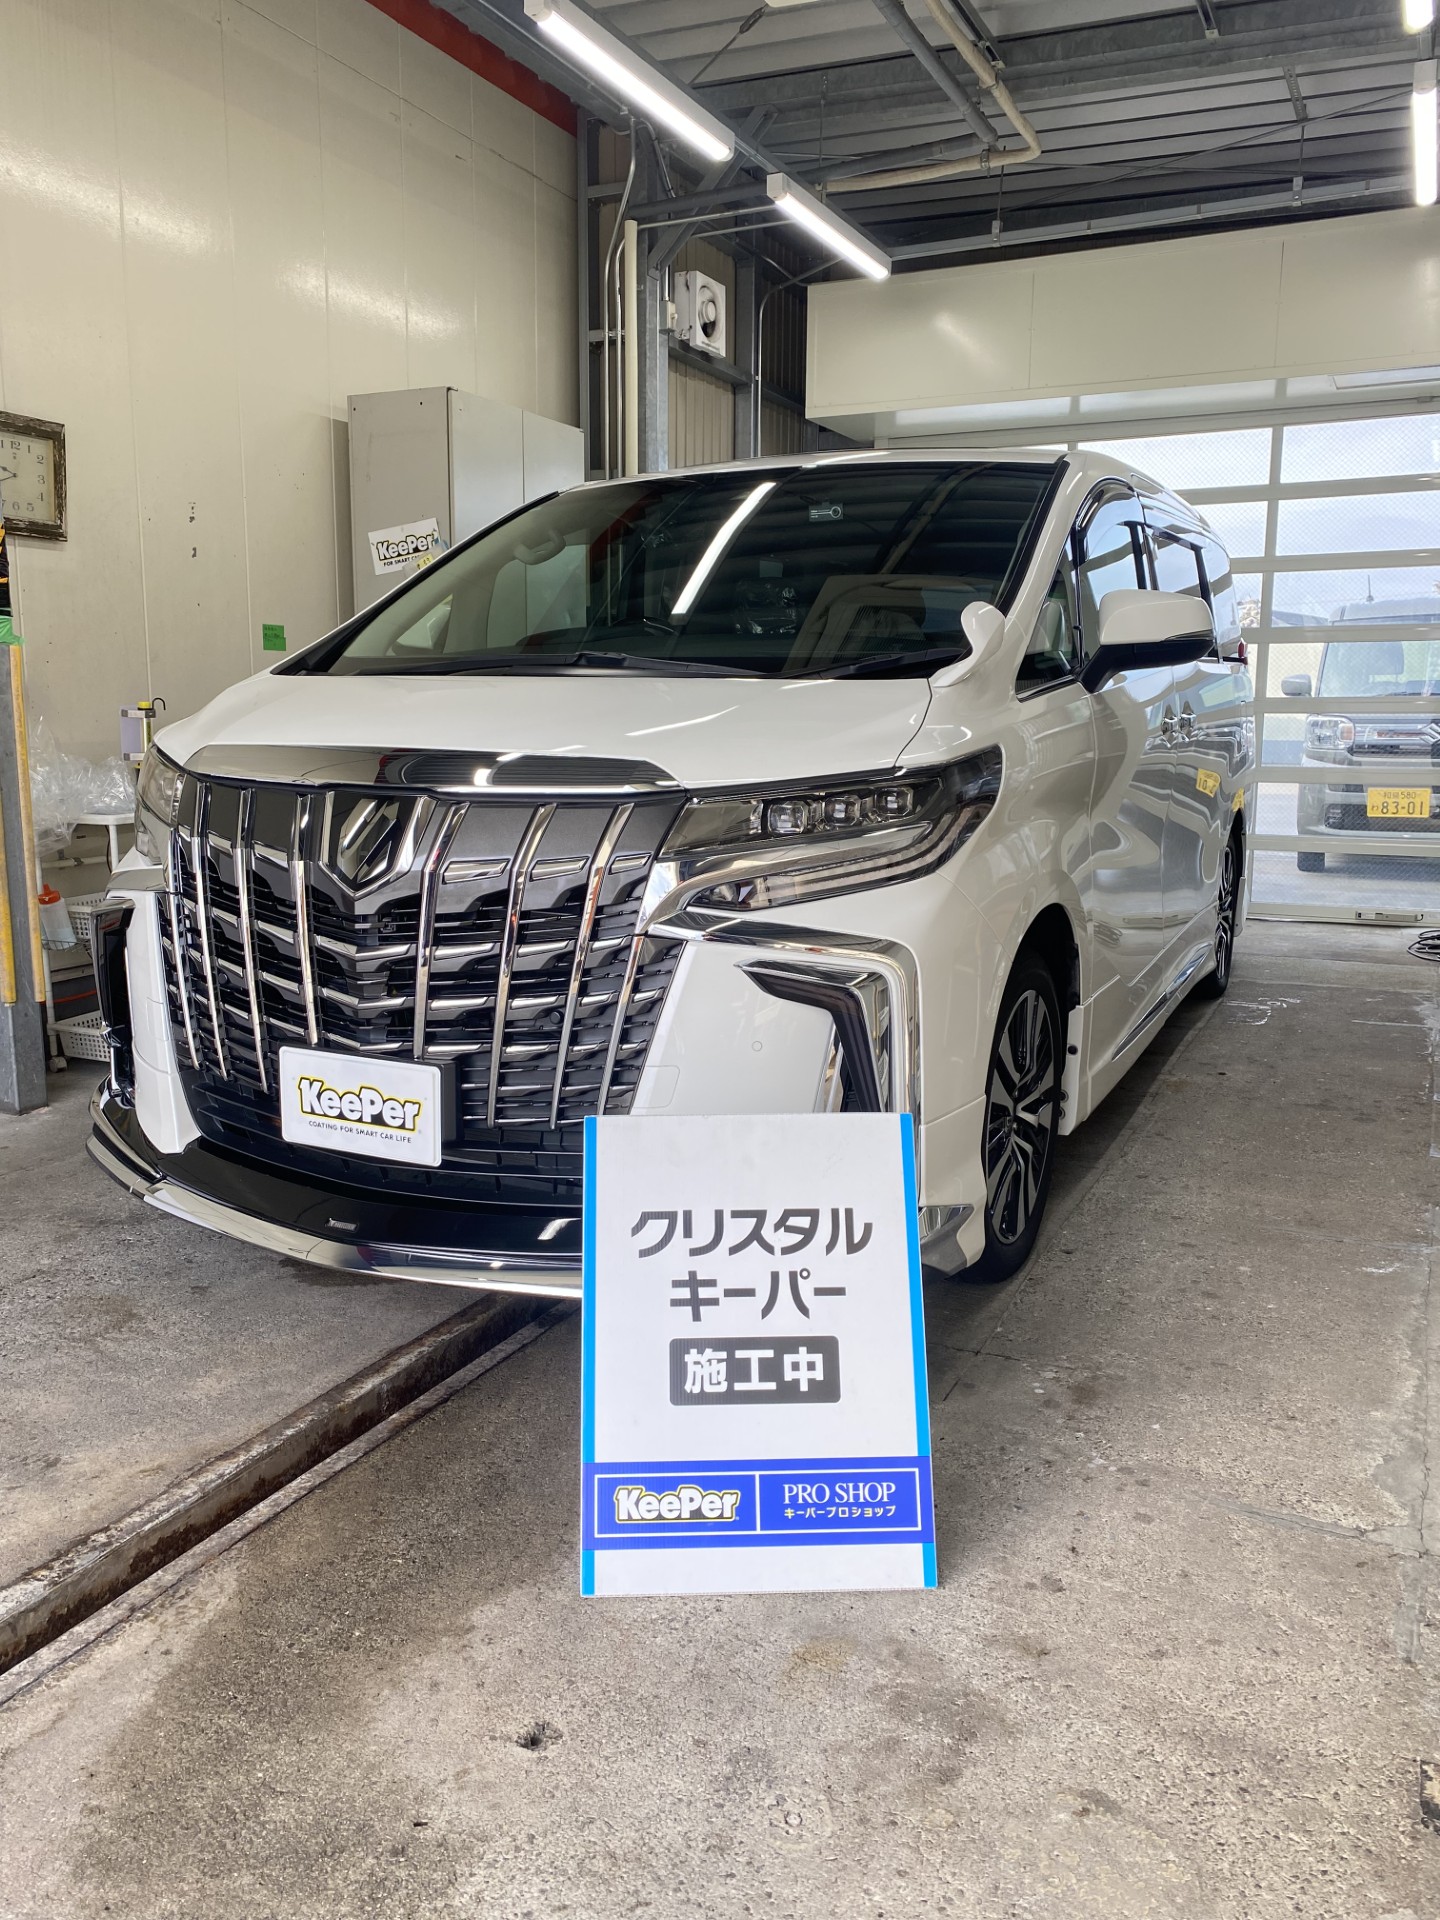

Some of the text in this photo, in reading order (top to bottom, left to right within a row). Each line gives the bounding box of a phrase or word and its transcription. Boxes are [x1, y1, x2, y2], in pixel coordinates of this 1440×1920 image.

[10, 441, 20, 450] 12
[28, 445, 30, 453] 1
[36, 455, 44, 464] 2
[38, 475, 45, 484] 3
[38, 492, 43, 501] 4
[12, 501, 20, 512] 6
[26, 502, 34, 512] 5
[376, 533, 434, 561] KeePer
[1381, 801, 1423, 815] 83-01
[298, 1076, 421, 1132] KeePer
[308, 1120, 412, 1144] COATING FOR SMART CAR LIFE
[631, 1207, 873, 1259] クリスタル
[669, 1267, 847, 1322] キーパー
[684, 1346, 825, 1394] 施工中
[783, 1482, 896, 1504] PRO SHOP
[614, 1485, 741, 1524] KeePer
